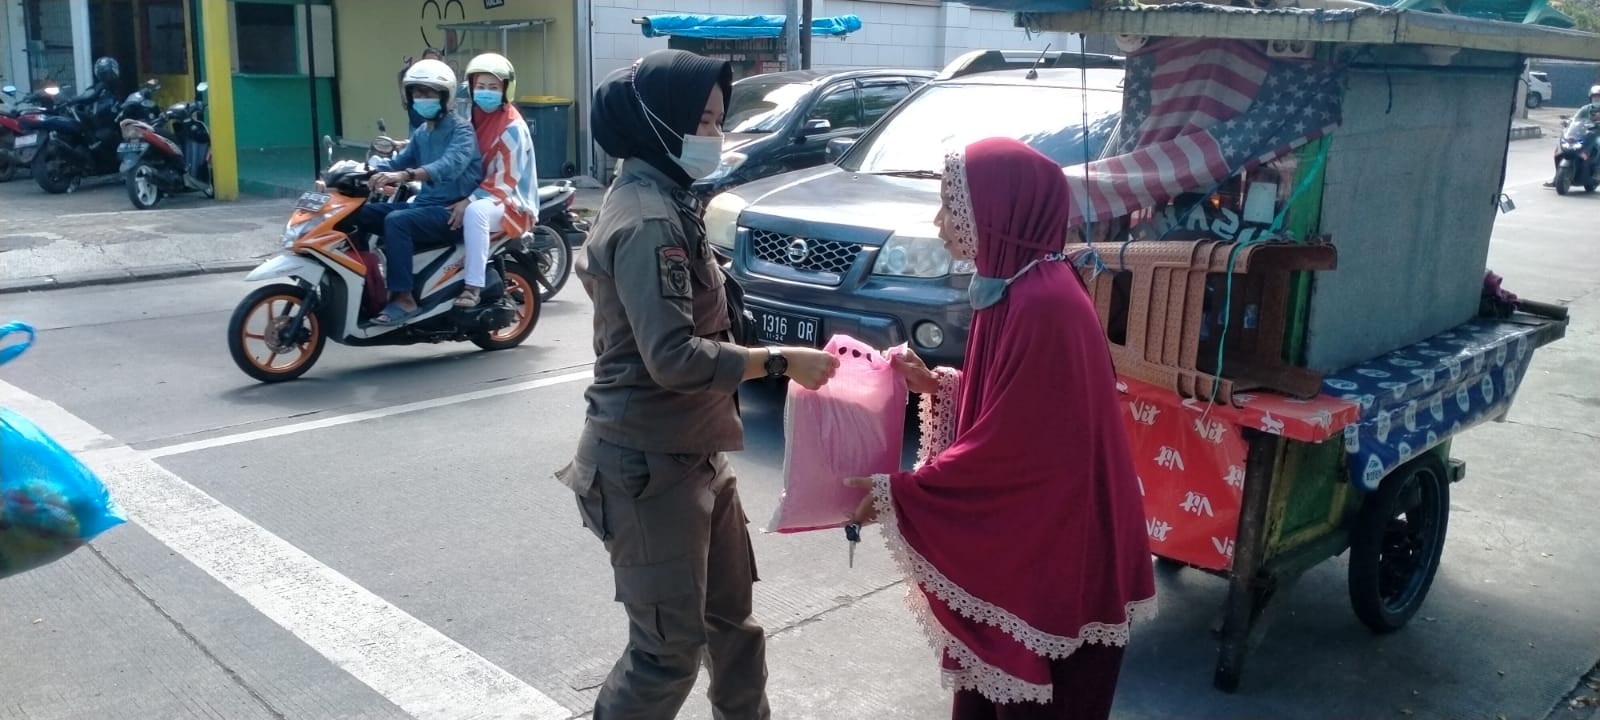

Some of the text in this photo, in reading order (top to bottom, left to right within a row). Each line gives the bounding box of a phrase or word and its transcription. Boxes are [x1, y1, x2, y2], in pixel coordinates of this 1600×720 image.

[762, 313, 787, 335] 1316
[1129, 400, 1161, 426] Vit
[1194, 418, 1227, 444] Vit
[1153, 446, 1185, 471] Vit
[1179, 491, 1214, 518] Vit
[1211, 536, 1234, 557] Vi
